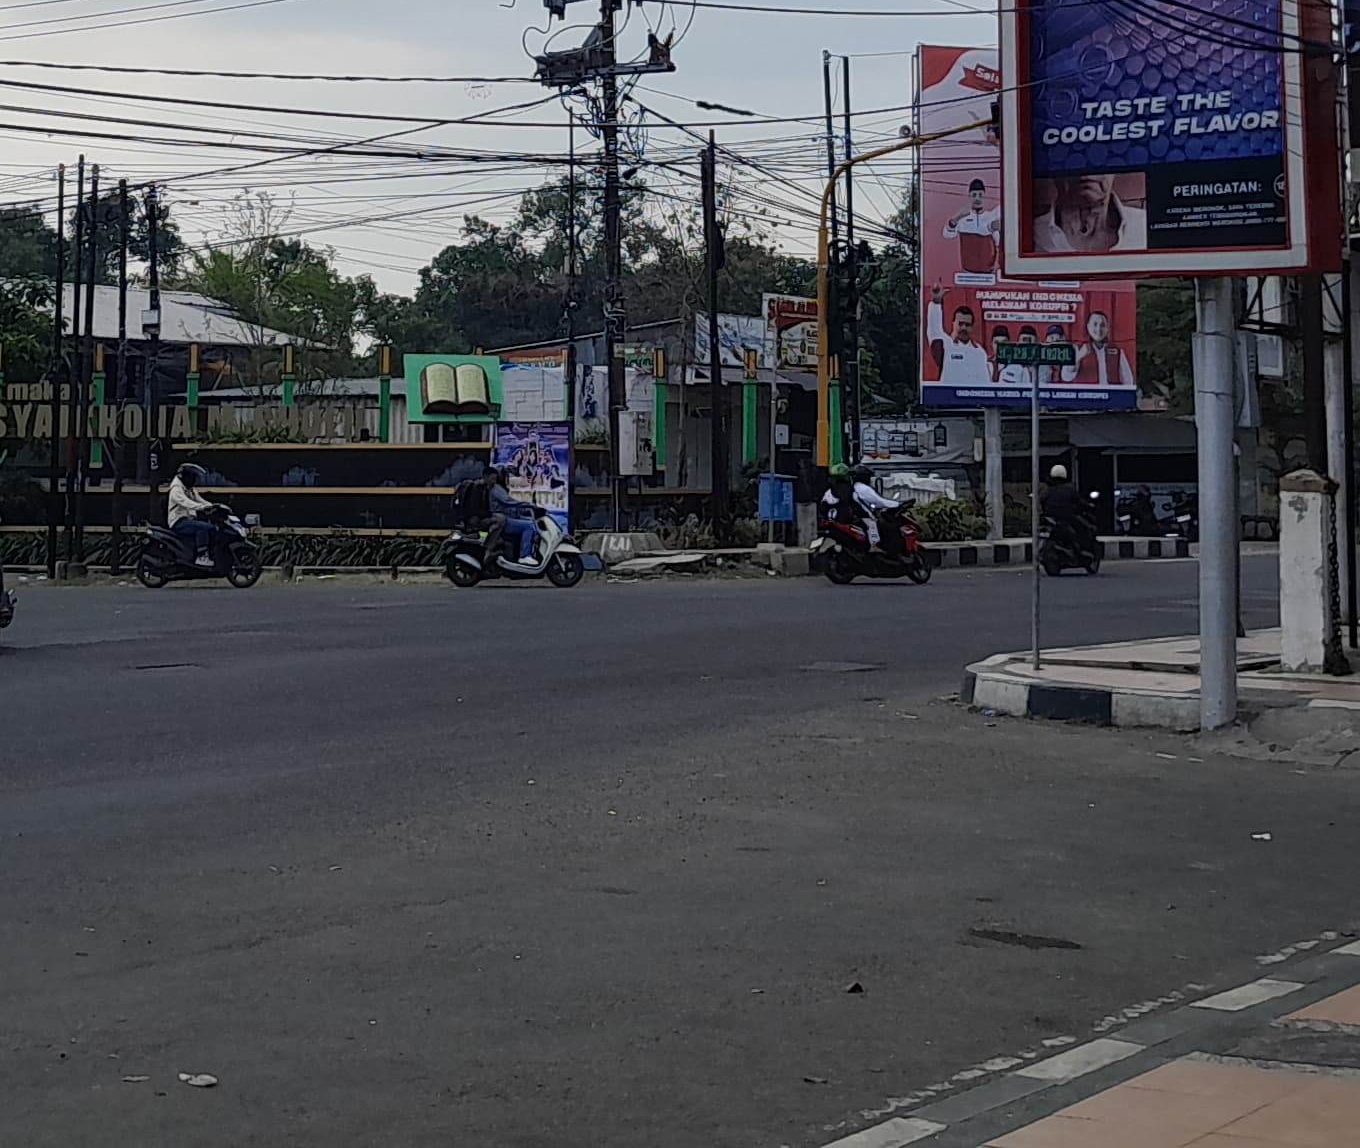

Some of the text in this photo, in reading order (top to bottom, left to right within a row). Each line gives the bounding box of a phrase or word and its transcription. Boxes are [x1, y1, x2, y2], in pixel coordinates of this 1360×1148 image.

[1081, 90, 1232, 119] TASTE THE
[1042, 111, 1281, 146] COOLEST FLAVOR
[1173, 181, 1264, 198] PERINGATAN:
